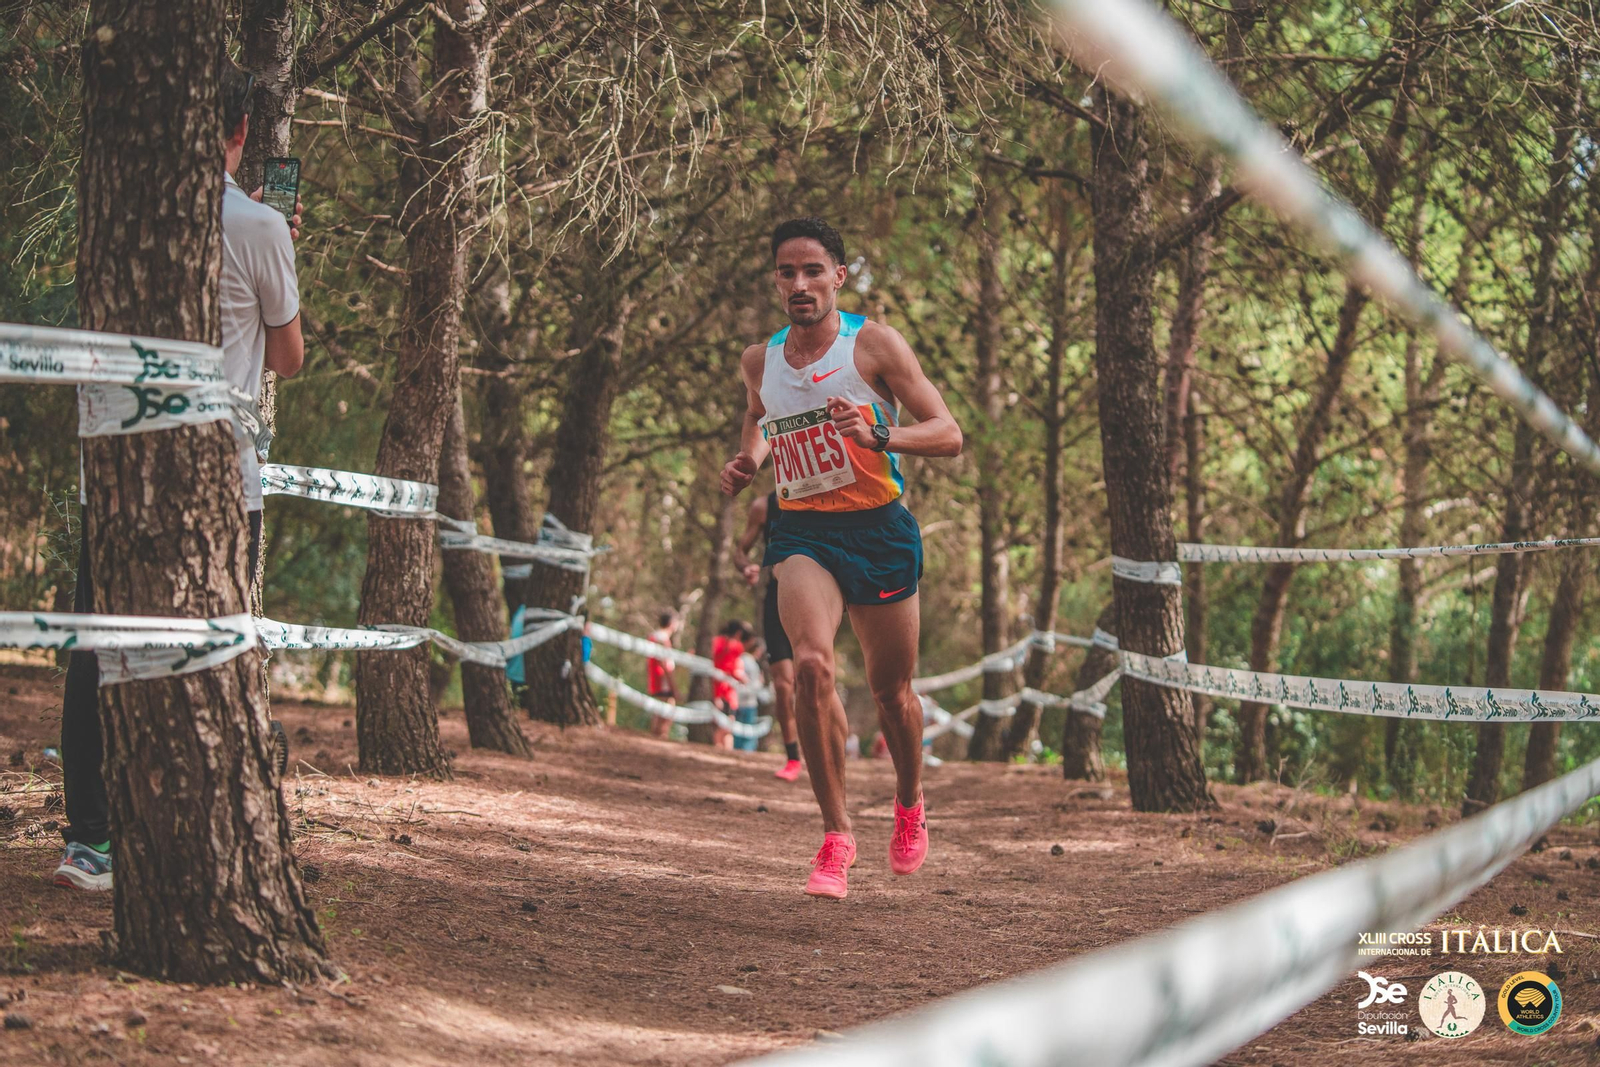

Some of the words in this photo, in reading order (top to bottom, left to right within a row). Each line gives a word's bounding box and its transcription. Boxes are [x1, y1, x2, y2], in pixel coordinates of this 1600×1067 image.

[9, 353, 64, 373] Sevilla
[780, 416, 810, 431] ITÁLICA
[770, 422, 845, 484] FONTES
